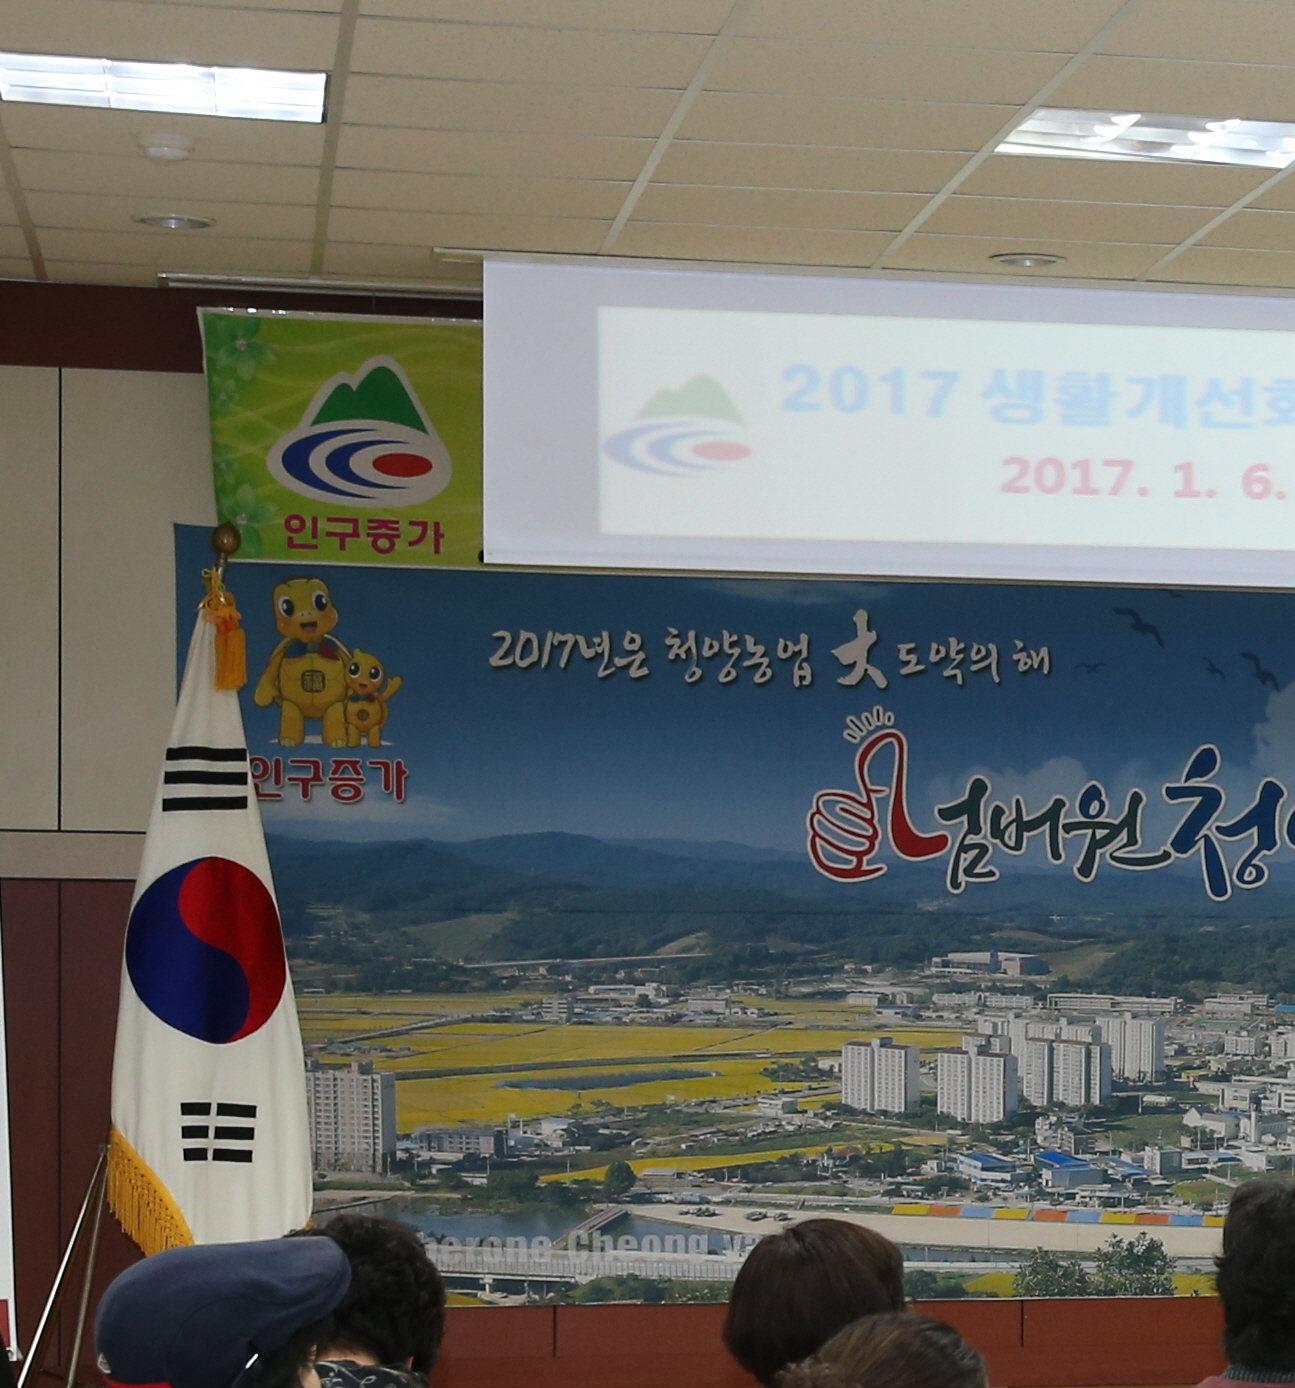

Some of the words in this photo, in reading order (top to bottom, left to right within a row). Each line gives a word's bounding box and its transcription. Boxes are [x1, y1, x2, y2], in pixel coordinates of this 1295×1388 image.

[780, 363, 962, 418] 2017
[1000, 456, 1151, 498] 2017.
[1172, 461, 1218, 500] 1.
[1241, 463, 1288, 501] 6.
[284, 513, 446, 555] 인구증가
[488, 629, 651, 680] 2017년은
[665, 626, 812, 688] 청양농업
[829, 608, 889, 690] 大
[896, 636, 1001, 686] 도약의
[1011, 639, 1051, 676] 해
[251, 755, 409, 804] 인구증가
